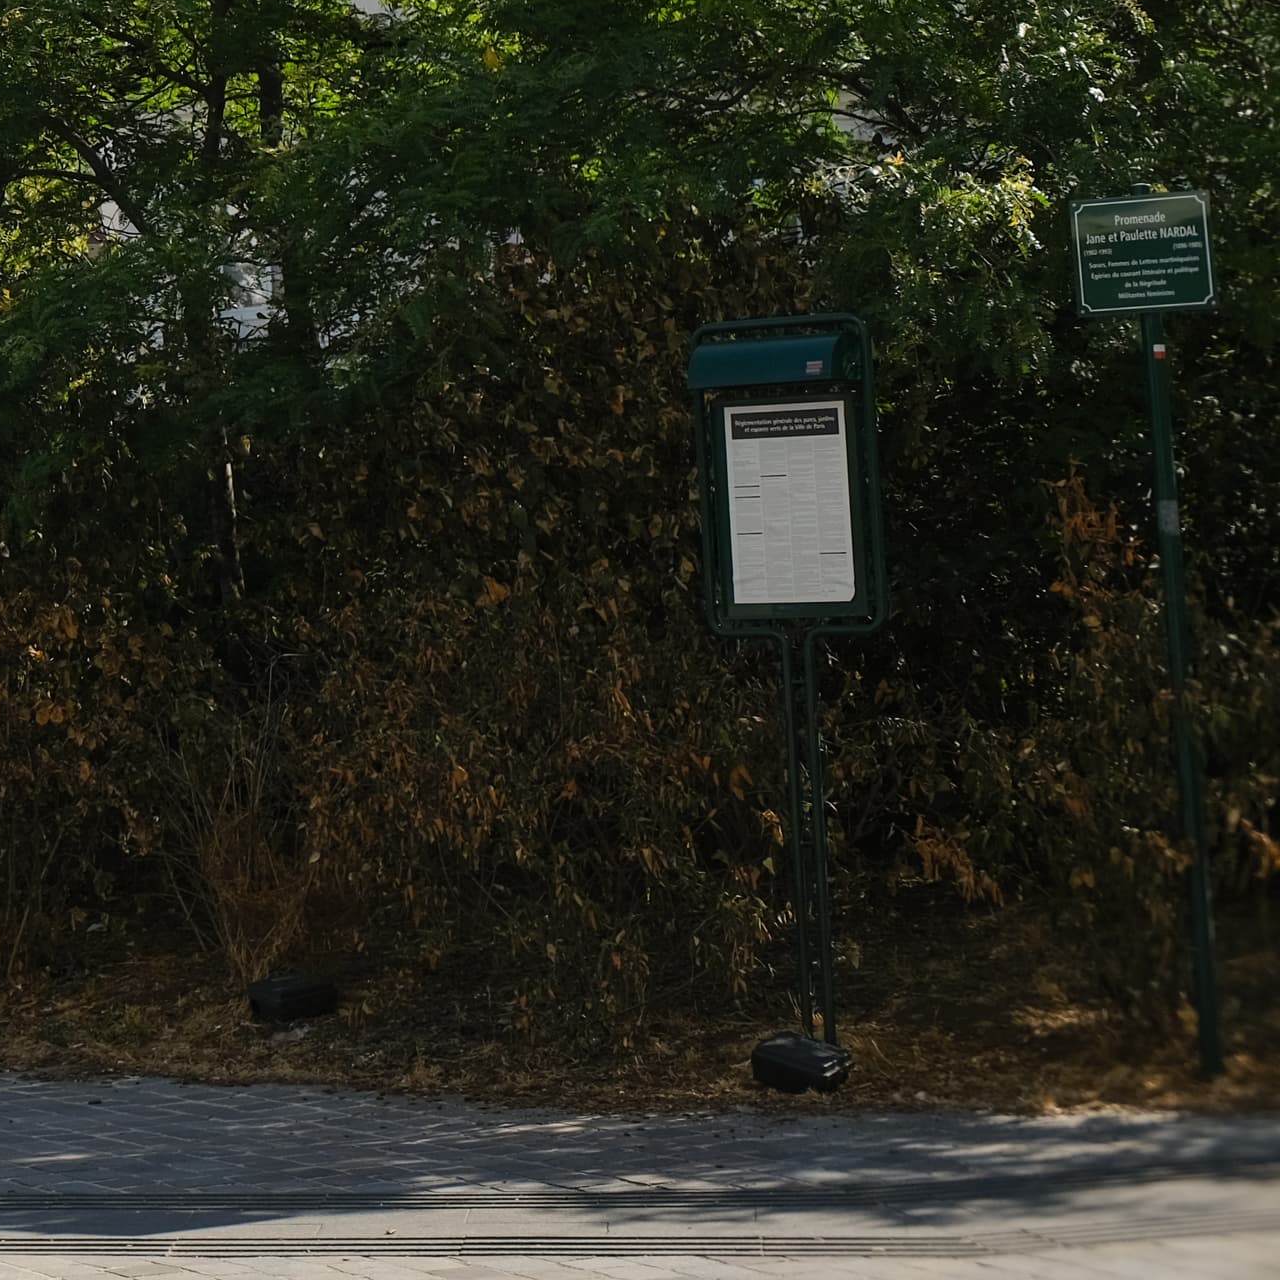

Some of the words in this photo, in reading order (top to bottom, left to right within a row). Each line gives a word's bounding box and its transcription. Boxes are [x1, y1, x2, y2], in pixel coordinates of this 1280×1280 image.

[1114, 211, 1166, 225] Promenade
[1086, 233, 1106, 245] Jane
[1108, 232, 1118, 242] et
[1120, 228, 1157, 241] Paulette
[1159, 225, 1198, 238] NARDAL
